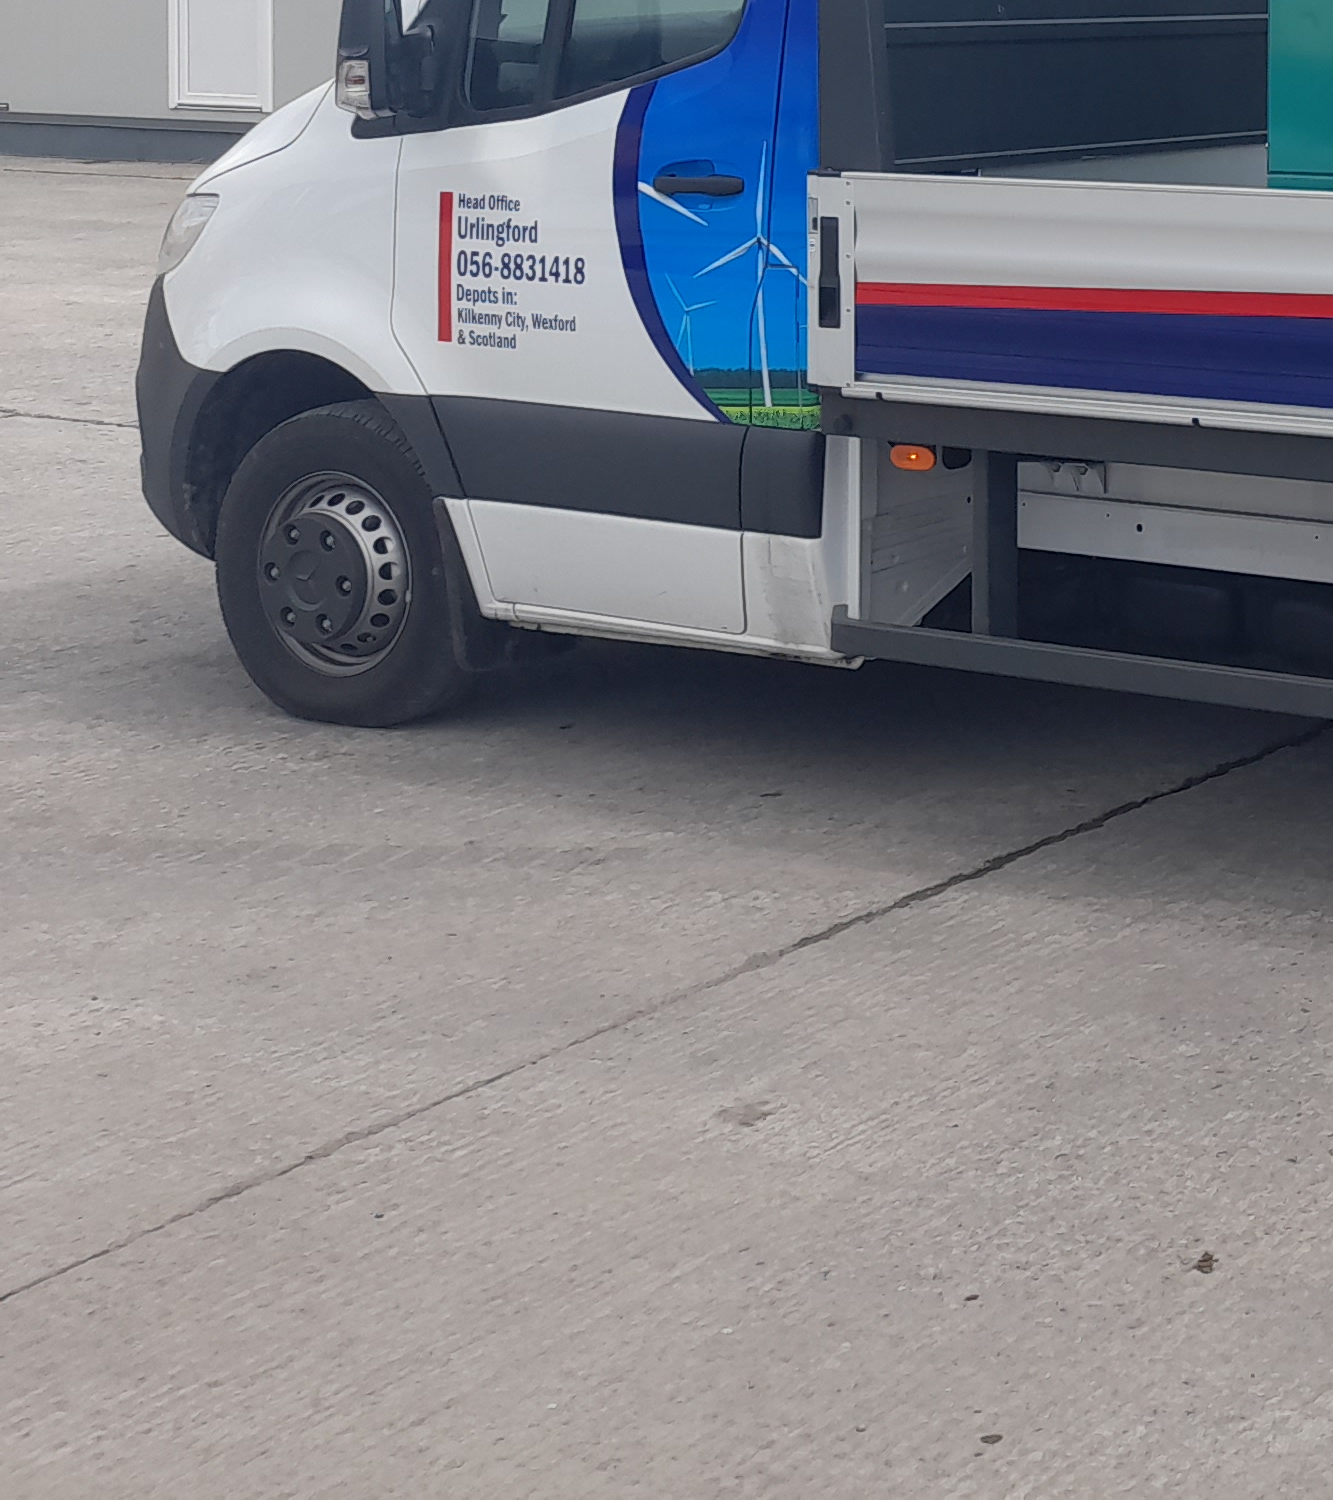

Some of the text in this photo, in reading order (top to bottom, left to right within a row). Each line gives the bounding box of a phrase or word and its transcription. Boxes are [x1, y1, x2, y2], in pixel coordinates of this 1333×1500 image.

[458, 193, 521, 212] Head Office
[457, 215, 538, 248] Urlingford
[456, 249, 586, 285] 056-8831418
[456, 283, 518, 306] Depots in:
[457, 307, 577, 332] Kilkenny City, Wexford
[457, 329, 517, 349] & Scotland
